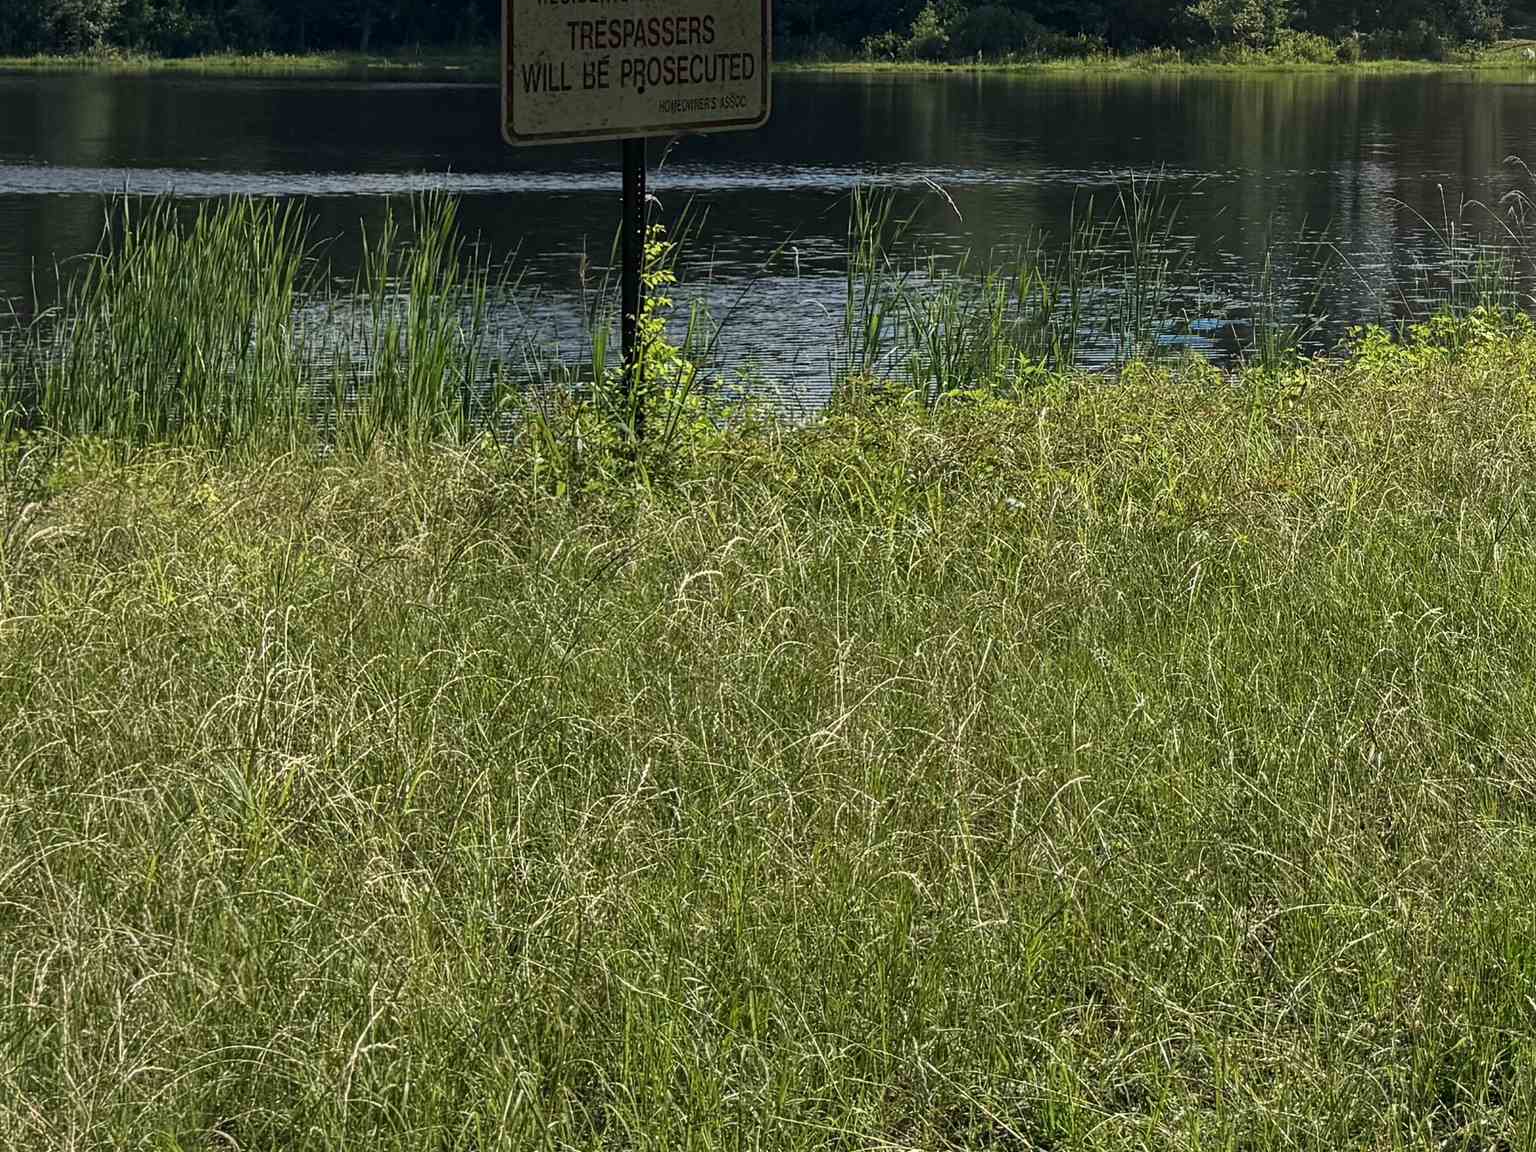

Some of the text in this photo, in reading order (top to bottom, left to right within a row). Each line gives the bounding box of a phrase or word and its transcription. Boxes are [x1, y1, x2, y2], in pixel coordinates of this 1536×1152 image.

[567, 15, 715, 51] TRESPASSERS
[521, 52, 755, 93] WILL BE PROSECUTED
